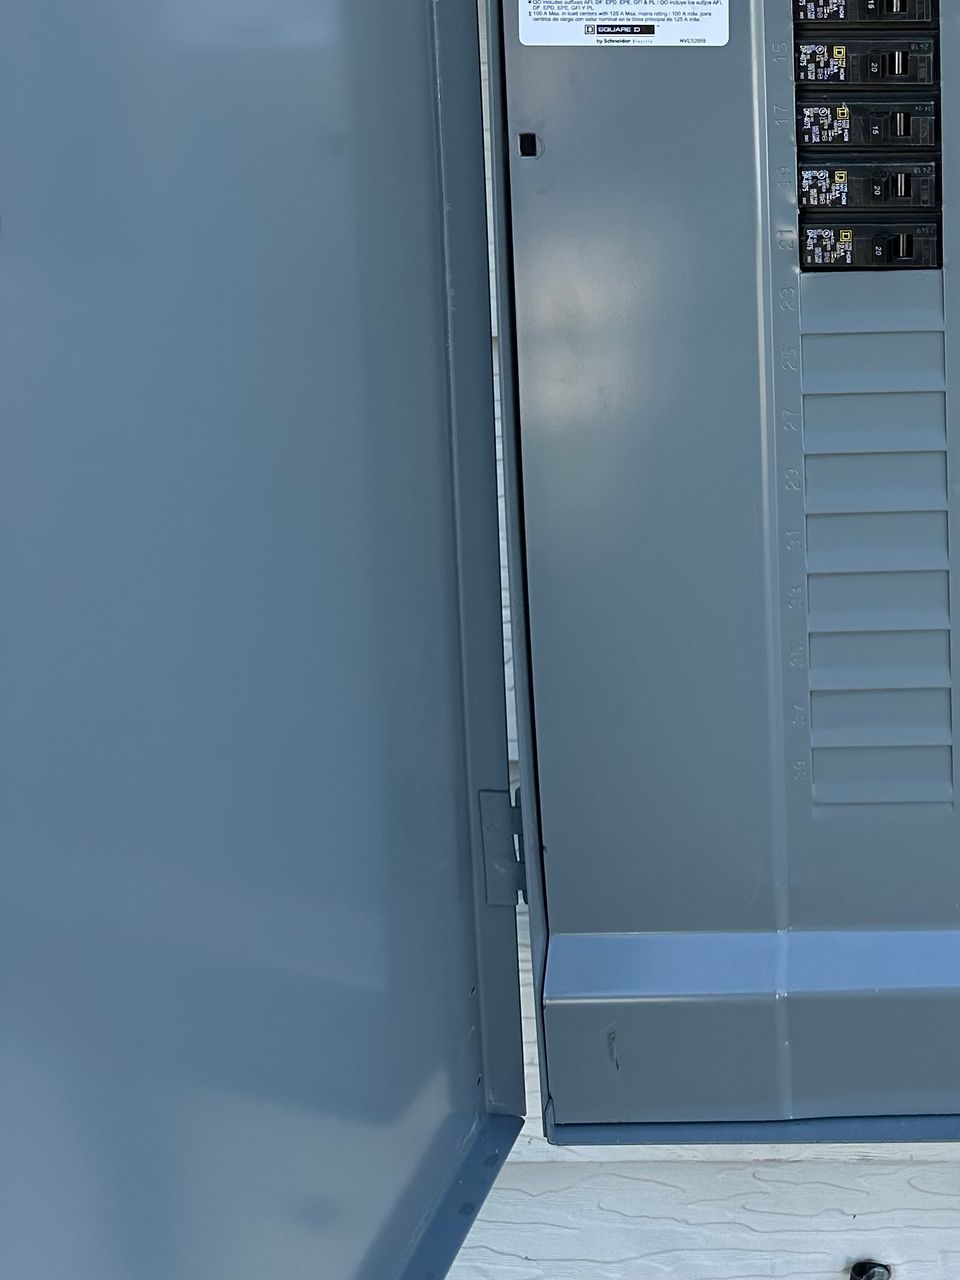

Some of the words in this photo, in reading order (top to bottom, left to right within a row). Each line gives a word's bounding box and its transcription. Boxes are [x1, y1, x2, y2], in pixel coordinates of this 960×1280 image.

[867, 0, 875, 9] 15
[871, 63, 878, 72] 20
[872, 126, 879, 135] 15
[874, 186, 881, 195] 20
[875, 246, 882, 256] 20
